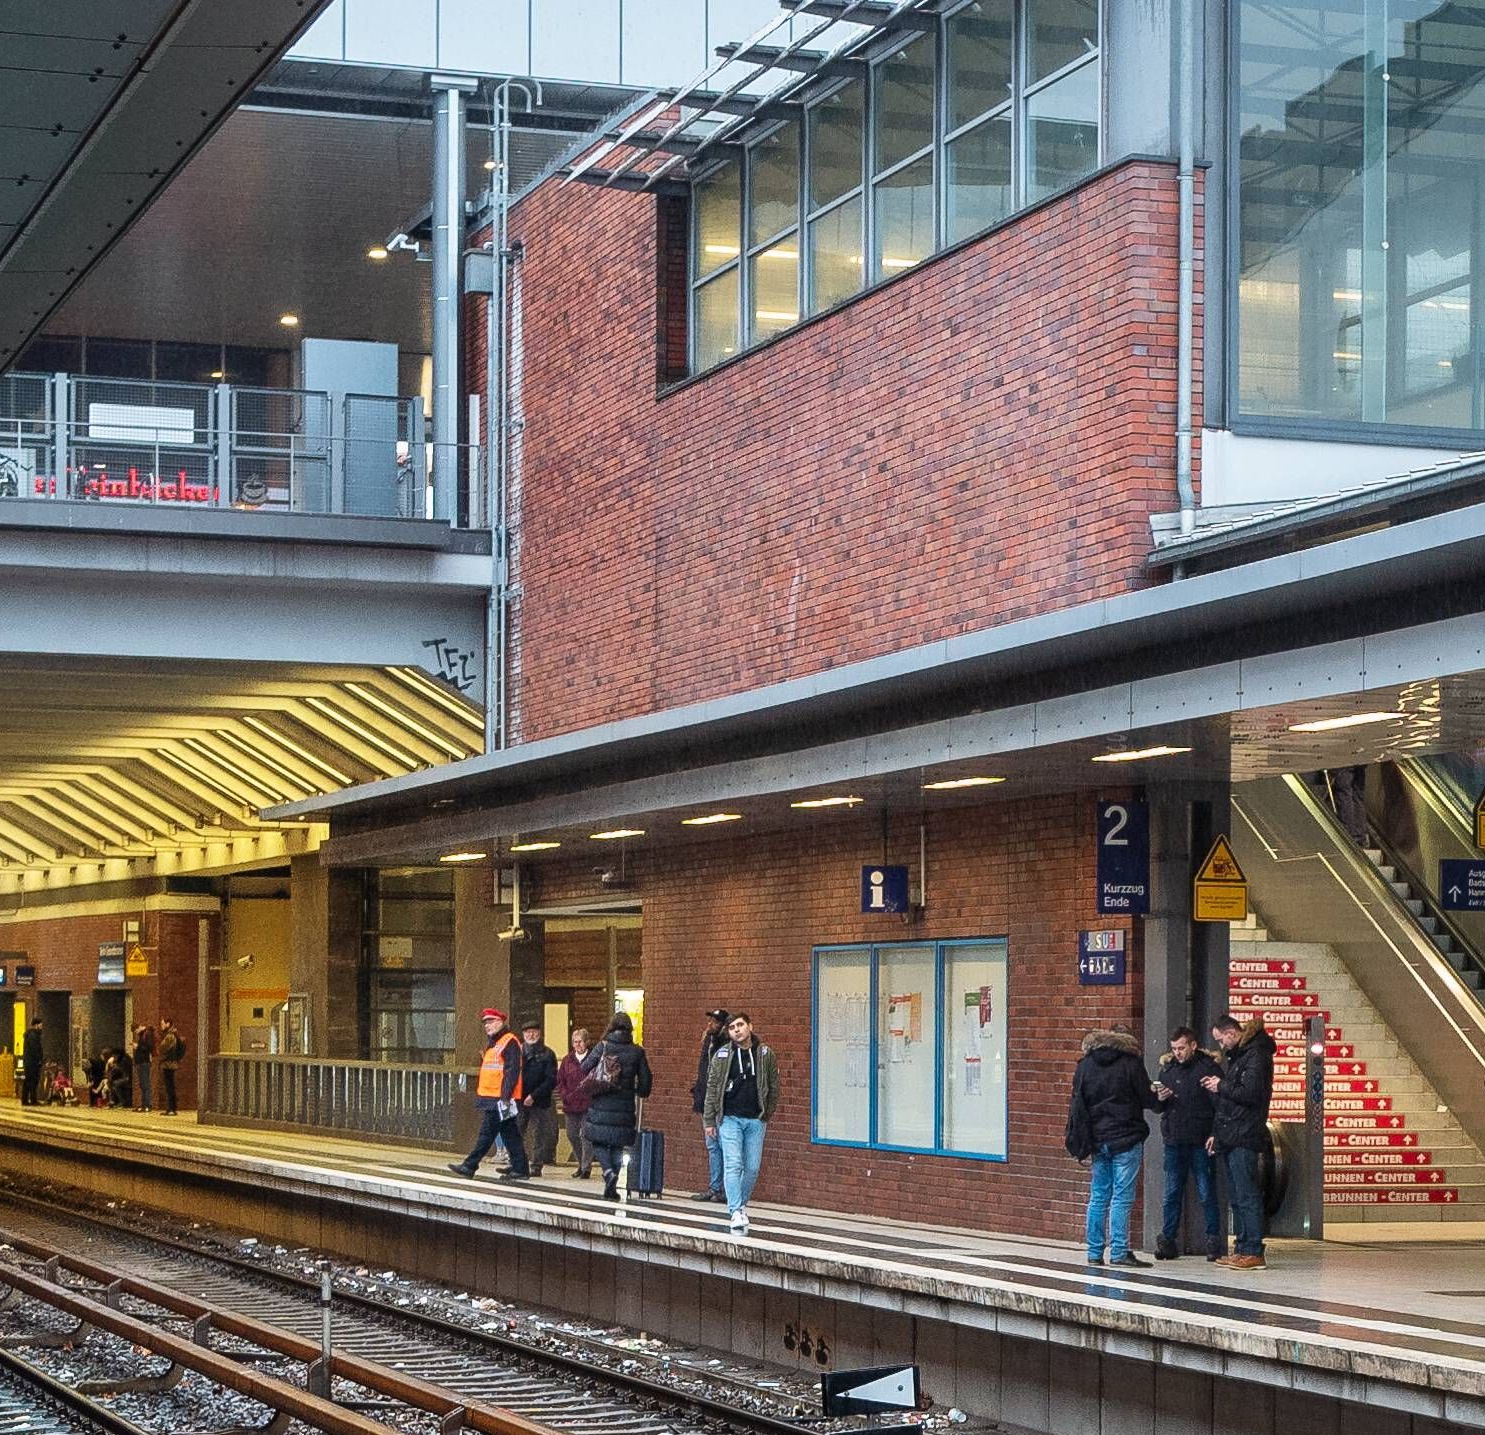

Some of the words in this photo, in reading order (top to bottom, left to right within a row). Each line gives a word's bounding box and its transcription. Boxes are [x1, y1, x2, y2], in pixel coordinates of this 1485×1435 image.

[1104, 805, 1128, 846] 2
[1104, 883, 1144, 896] Kurzzug
[1104, 896, 1130, 907] Ende
[1240, 978, 1279, 988] CENTER
[1252, 995, 1291, 1005] CENTER
[1263, 1012, 1302, 1022] CENTER
[1335, 1117, 1376, 1127] CENTER
[1348, 1135, 1389, 1145] CENTER
[1361, 1153, 1403, 1164] CENTER
[1374, 1172, 1416, 1182] CENTER
[1388, 1191, 1429, 1202] CENTER
